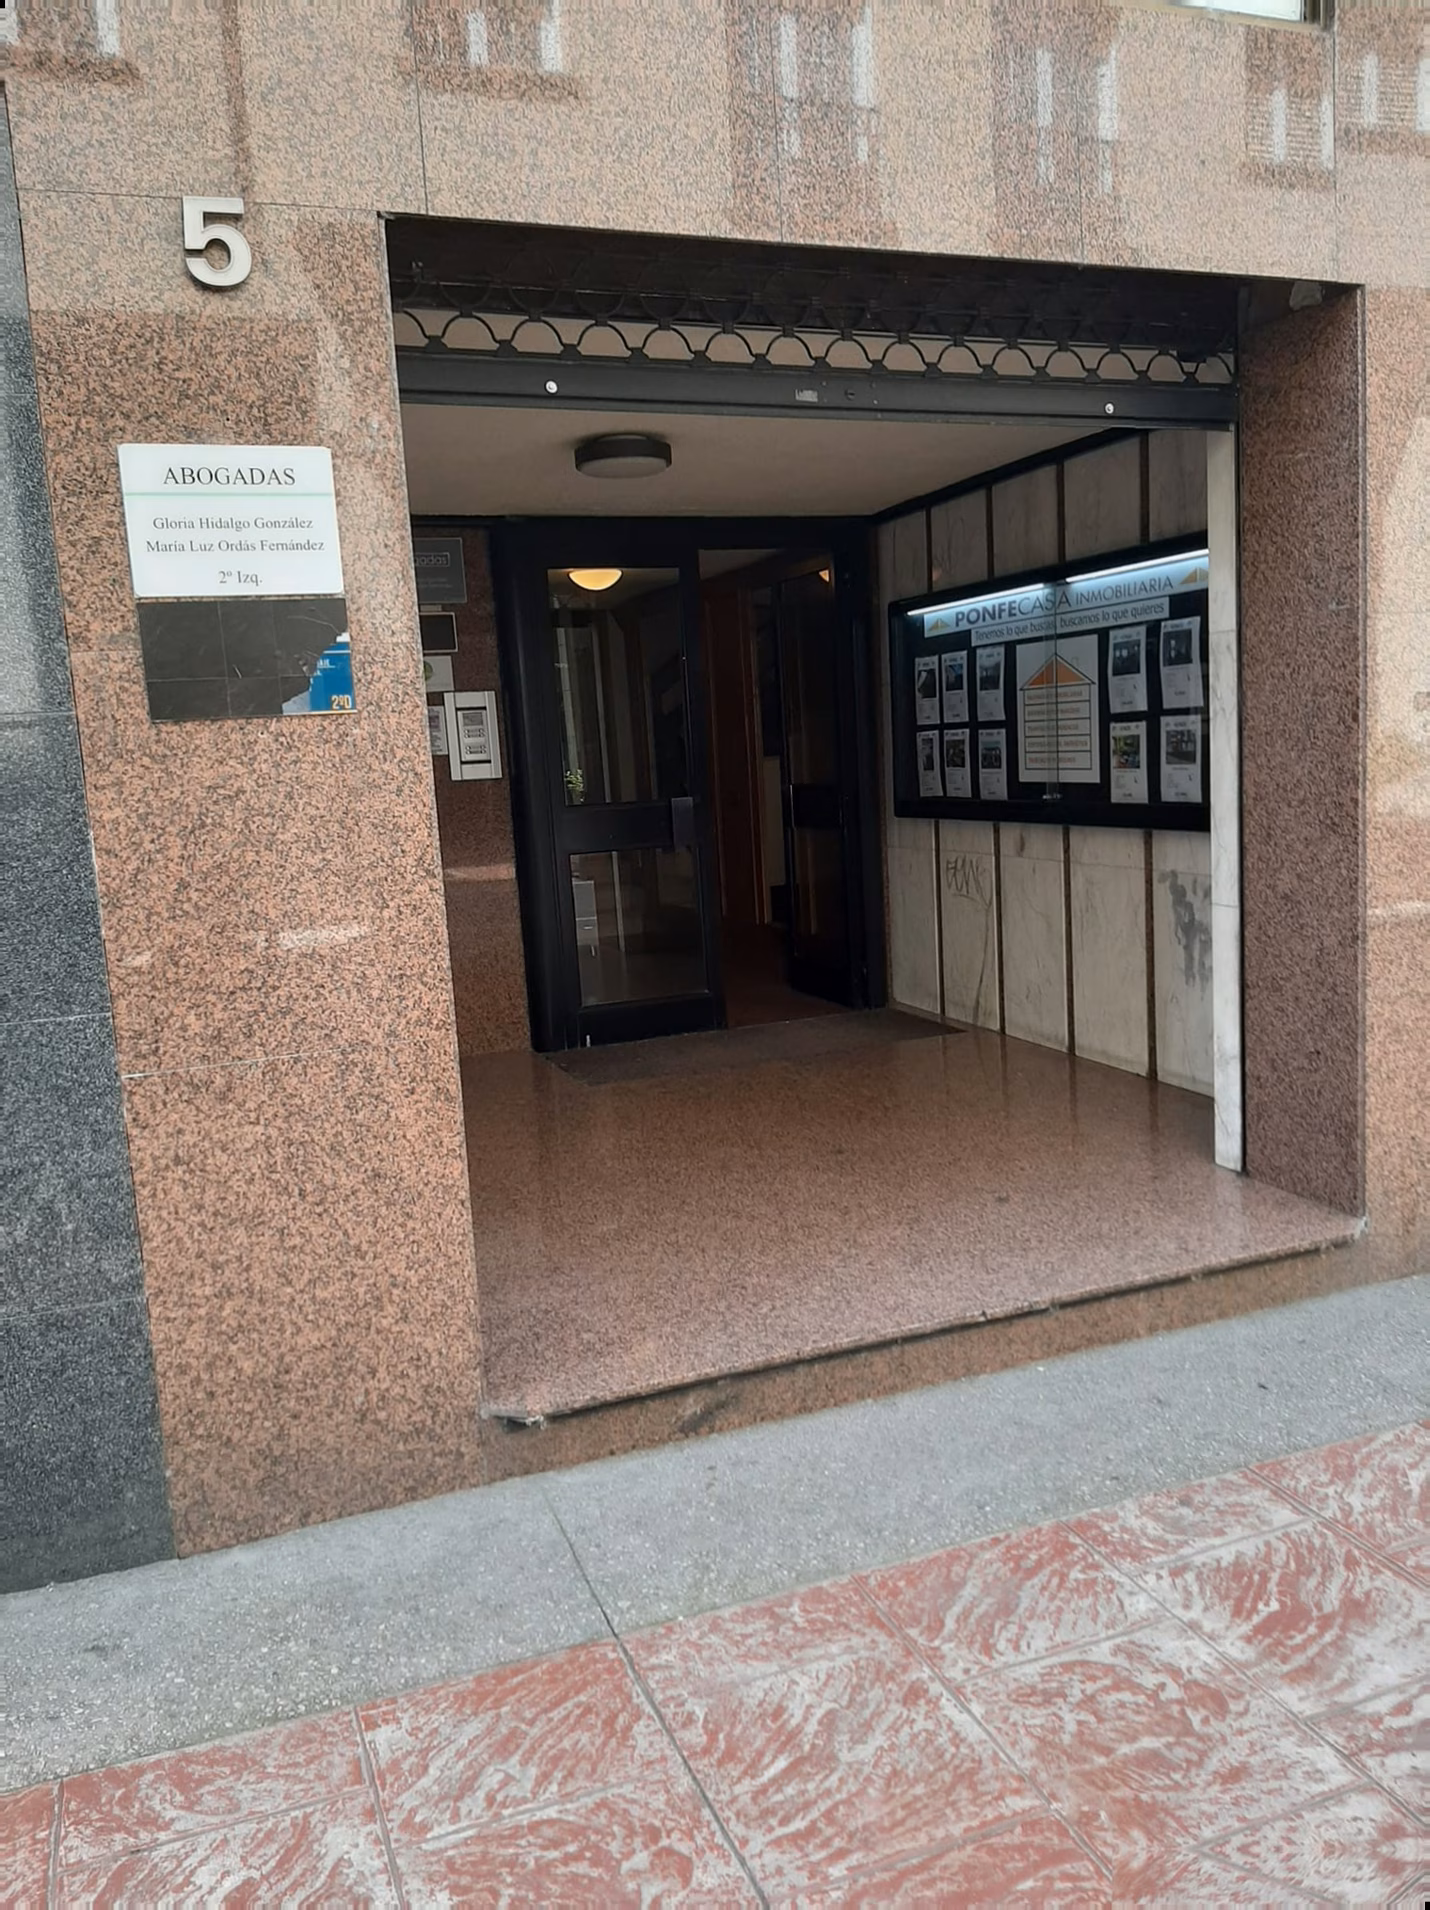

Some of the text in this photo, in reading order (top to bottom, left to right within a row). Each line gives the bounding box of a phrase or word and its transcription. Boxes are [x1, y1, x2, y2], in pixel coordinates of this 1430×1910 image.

[183, 195, 252, 287] 5
[163, 466, 296, 486] ABOGADAS
[153, 517, 313, 532] Gloria Hidalgo González
[146, 539, 325, 552] María Luz Ordás Fernández
[237, 571, 263, 586] Izq.
[955, 576, 1174, 627] PONFECASA INMOBILIARIA
[975, 627, 1005, 641] Tenemos
[1006, 625, 1014, 636] lo
[1015, 624, 1029, 637] que
[1060, 611, 1099, 628] buscamos
[1102, 609, 1110, 621] lo
[1112, 608, 1129, 622] que
[1131, 602, 1164, 616] quieres
